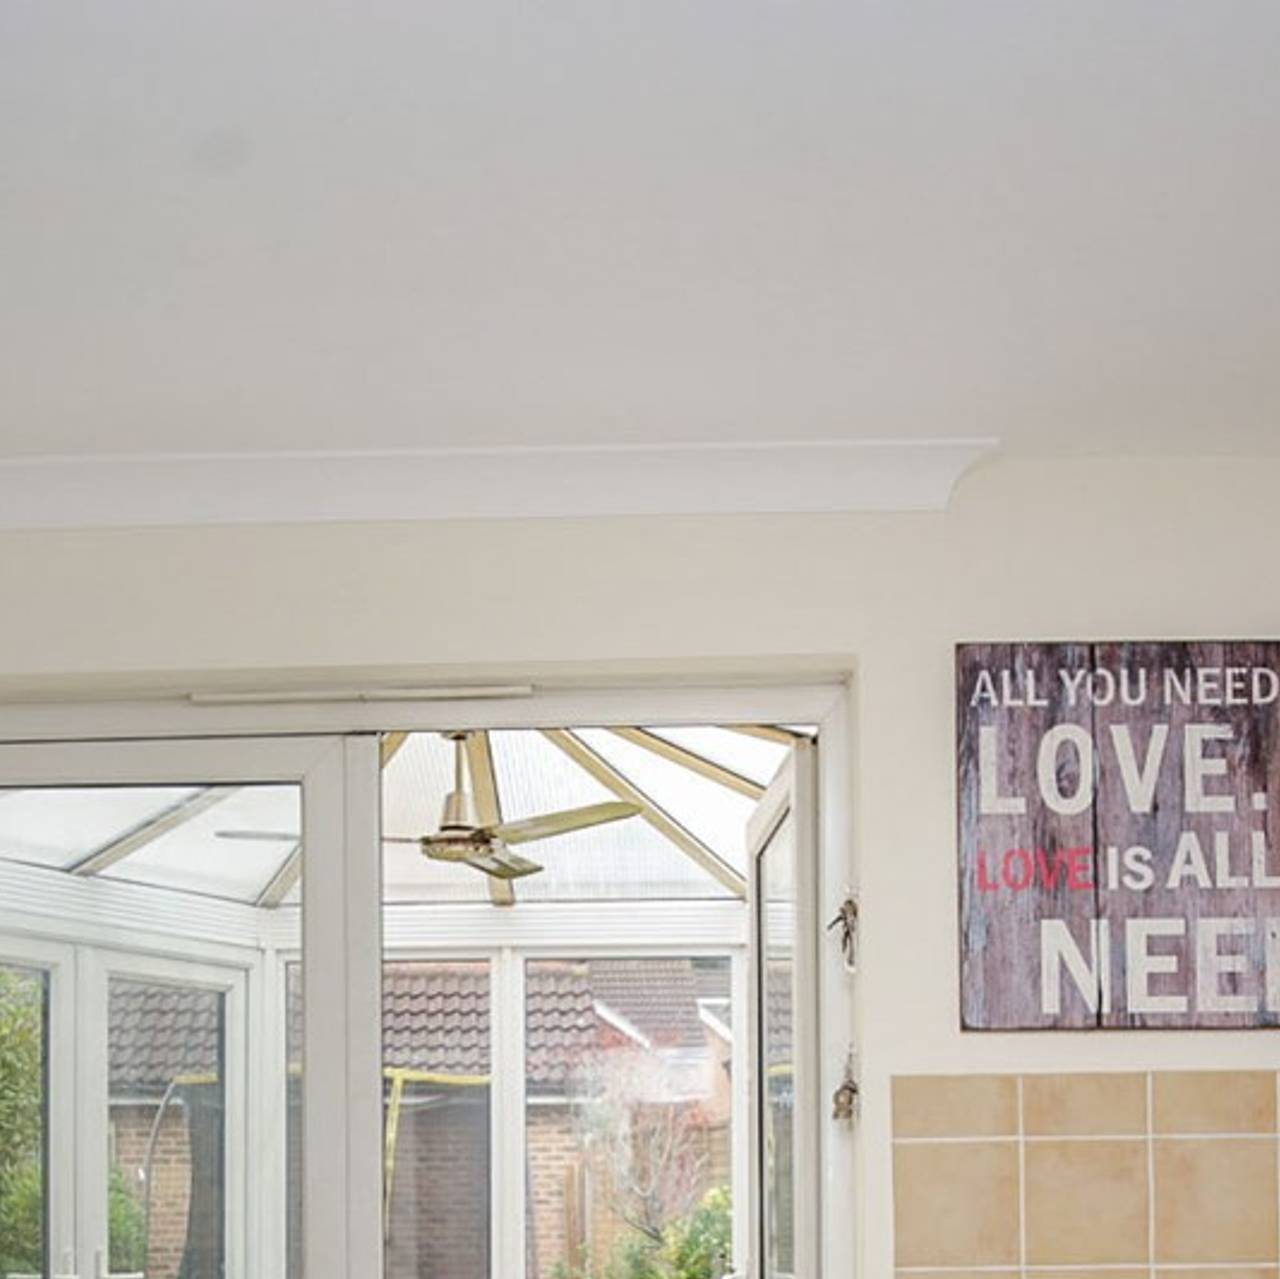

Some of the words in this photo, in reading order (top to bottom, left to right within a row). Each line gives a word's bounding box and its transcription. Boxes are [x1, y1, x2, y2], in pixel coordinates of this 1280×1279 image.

[971, 668, 1048, 706] ALL
[1058, 667, 1146, 706] YOU
[1164, 666, 1280, 705] NEED
[977, 847, 1095, 893] LOVE
[1107, 846, 1155, 891] IS
